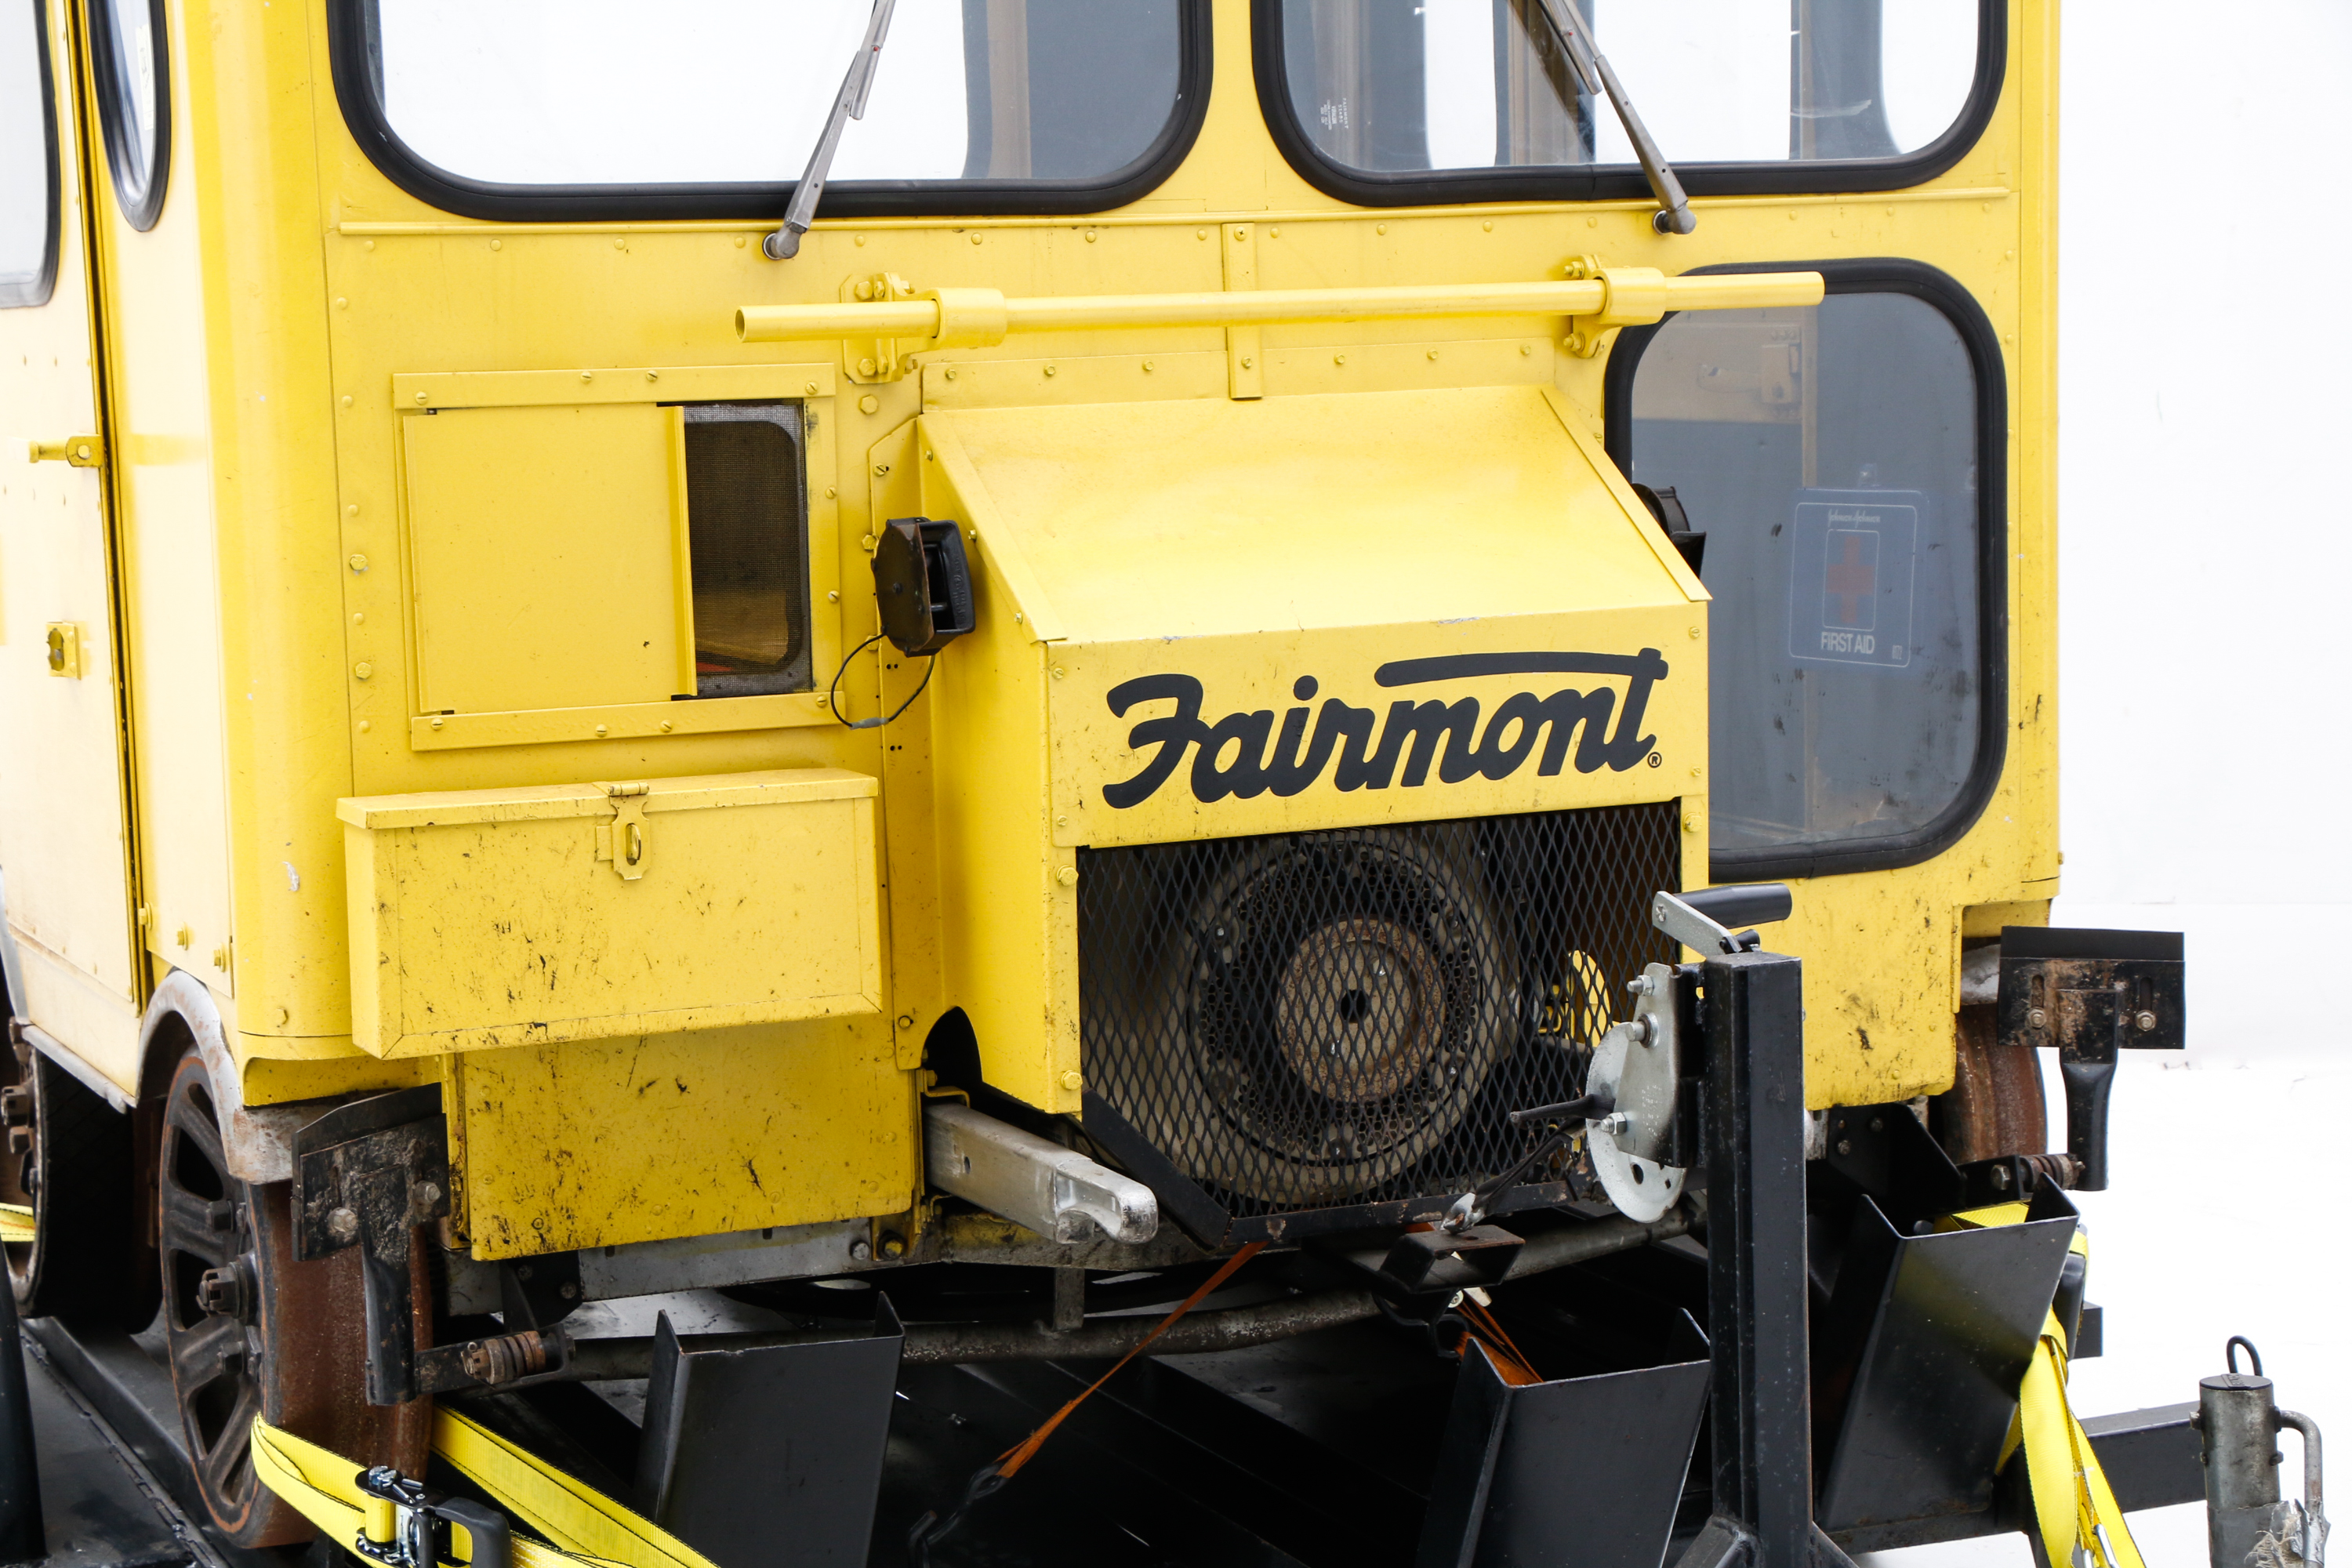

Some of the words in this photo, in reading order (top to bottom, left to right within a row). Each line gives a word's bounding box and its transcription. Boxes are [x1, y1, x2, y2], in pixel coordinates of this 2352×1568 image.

[1820, 631, 1854, 653] FIRST
[1854, 634, 1875, 655] AID
[1102, 648, 1668, 809] Fairmont
